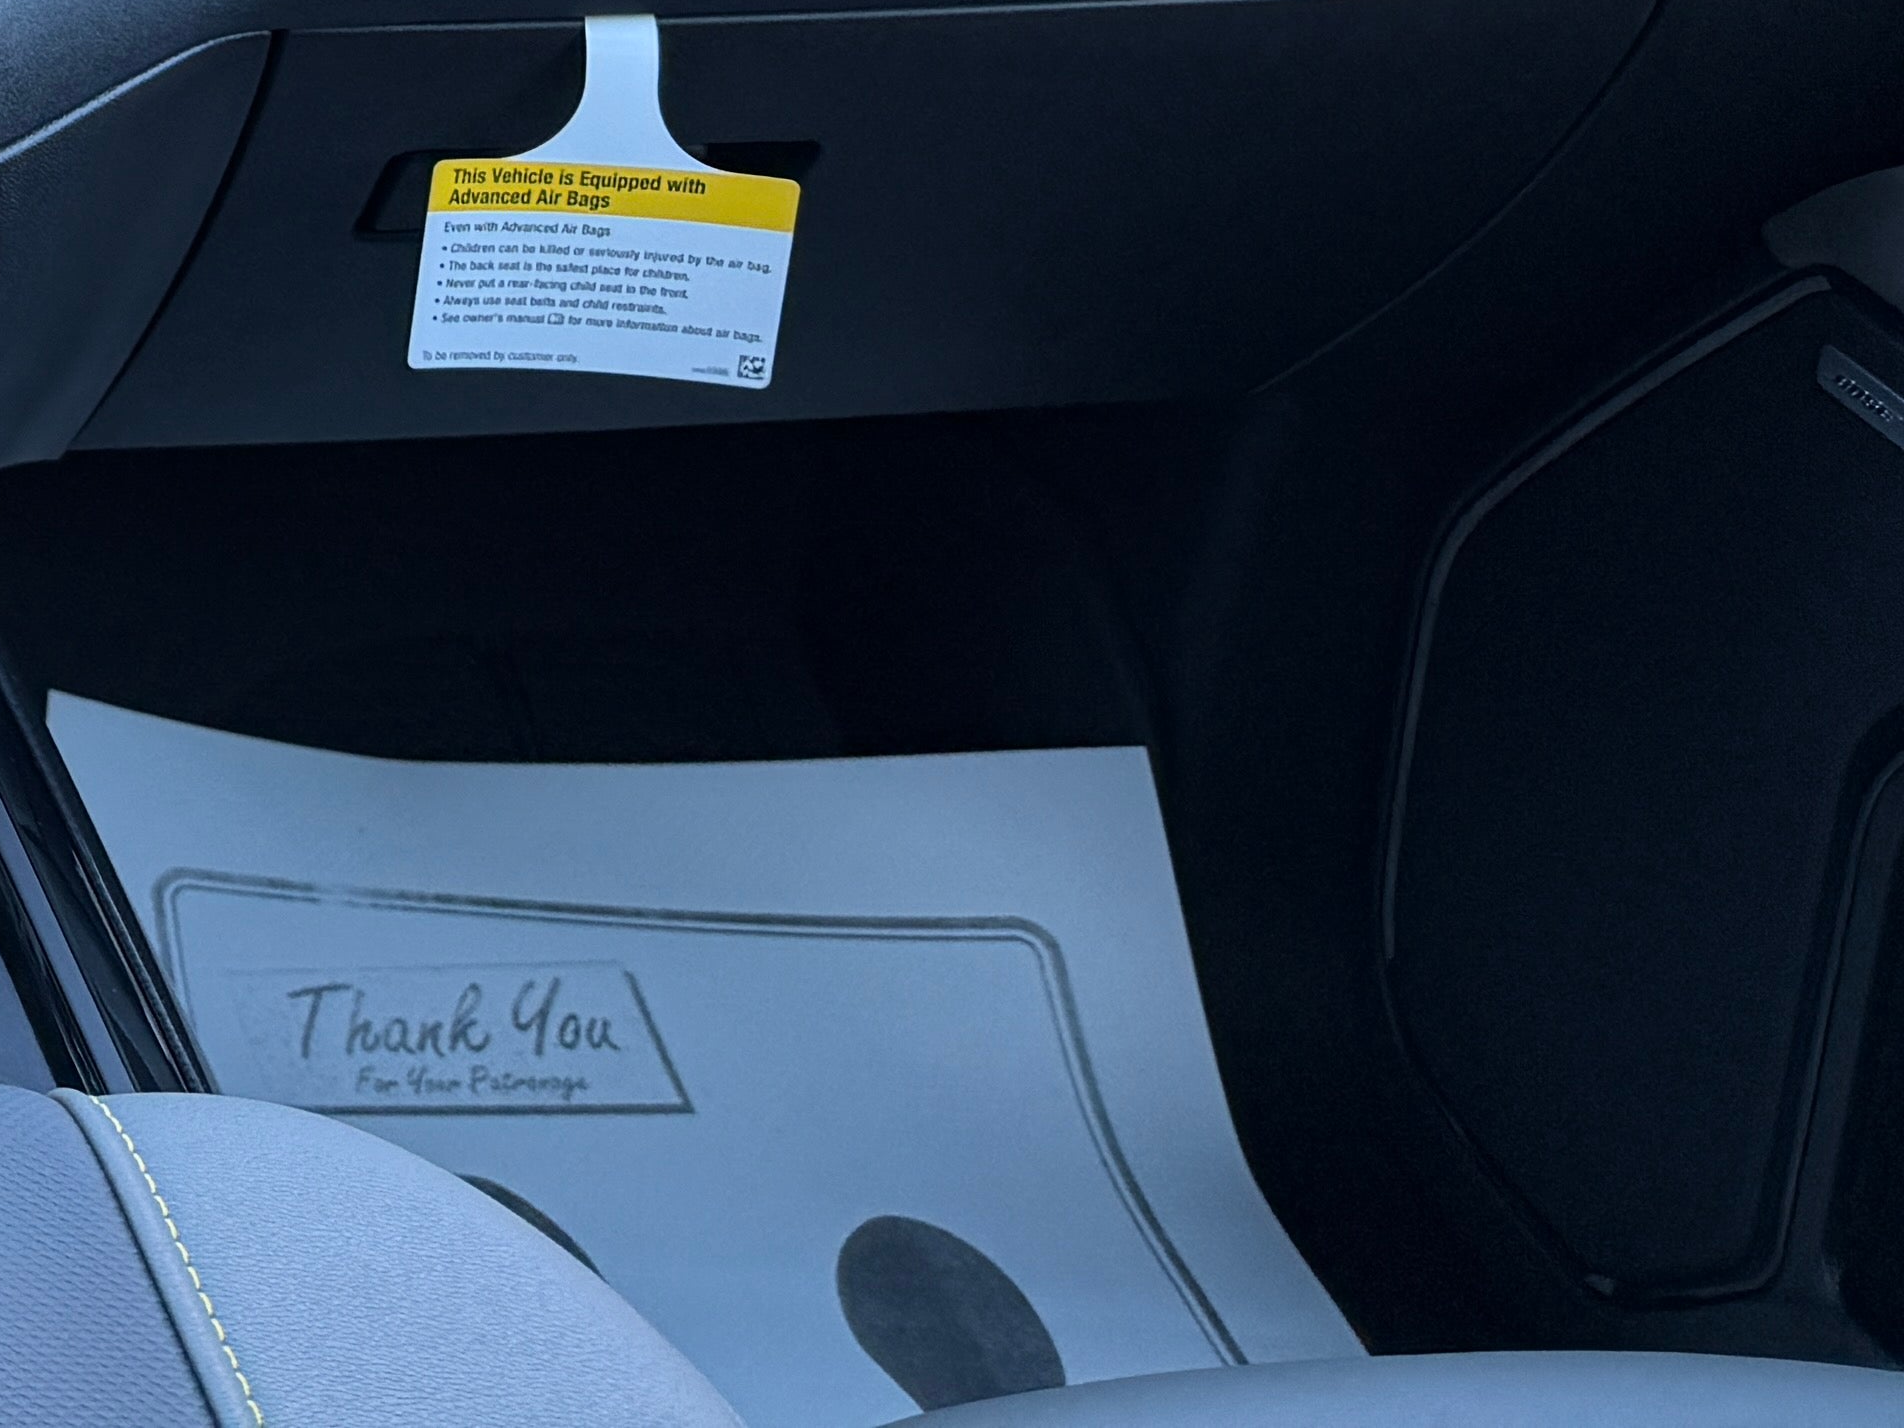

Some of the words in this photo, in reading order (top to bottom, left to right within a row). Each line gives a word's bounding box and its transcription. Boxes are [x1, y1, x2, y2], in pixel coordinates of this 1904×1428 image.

[454, 168, 486, 184] This
[491, 167, 554, 185] Vehicle
[559, 169, 574, 185] is
[580, 171, 662, 193] Equipped
[667, 177, 706, 194] with
[448, 188, 531, 205] Advanced
[536, 189, 562, 205] Air
[567, 191, 610, 210] Bags
[444, 221, 471, 233] Even
[474, 221, 498, 232] with
[501, 222, 559, 234] Advanced
[561, 223, 578, 234] Air
[582, 224, 611, 237] Bags
[451, 243, 496, 254] Children
[498, 246, 519, 254] can
[522, 244, 536, 254] be
[539, 245, 570, 255] killed
[574, 248, 585, 256] or
[644, 251, 684, 264] injured
[688, 255, 702, 267] by
[706, 256, 724, 267] the
[728, 258, 743, 269] air
[449, 261, 467, 271] The
[470, 261, 494, 271] back
[498, 262, 520, 272] seat
[524, 261, 532, 271] is
[536, 262, 552, 272] the
[556, 263, 588, 274] safest
[591, 265, 621, 276] place
[624, 267, 640, 277] for
[446, 279, 476, 288] Never
[478, 279, 496, 290] put
[570, 281, 596, 291] child
[599, 283, 623, 293] seat
[626, 284, 636, 294] in
[640, 285, 657, 295] the
[443, 296, 480, 307] Always
[483, 297, 502, 305] use
[505, 297, 527, 306] seat
[559, 298, 579, 308] and
[583, 300, 609, 310] child
[441, 313, 460, 323] See
[506, 314, 545, 324] manual
[568, 315, 582, 325] for
[286, 982, 490, 1060] Thank
[512, 976, 620, 1057] You
[355, 1065, 398, 1094] For
[407, 1065, 462, 1095] Your
[470, 1064, 589, 1100] Patronage
